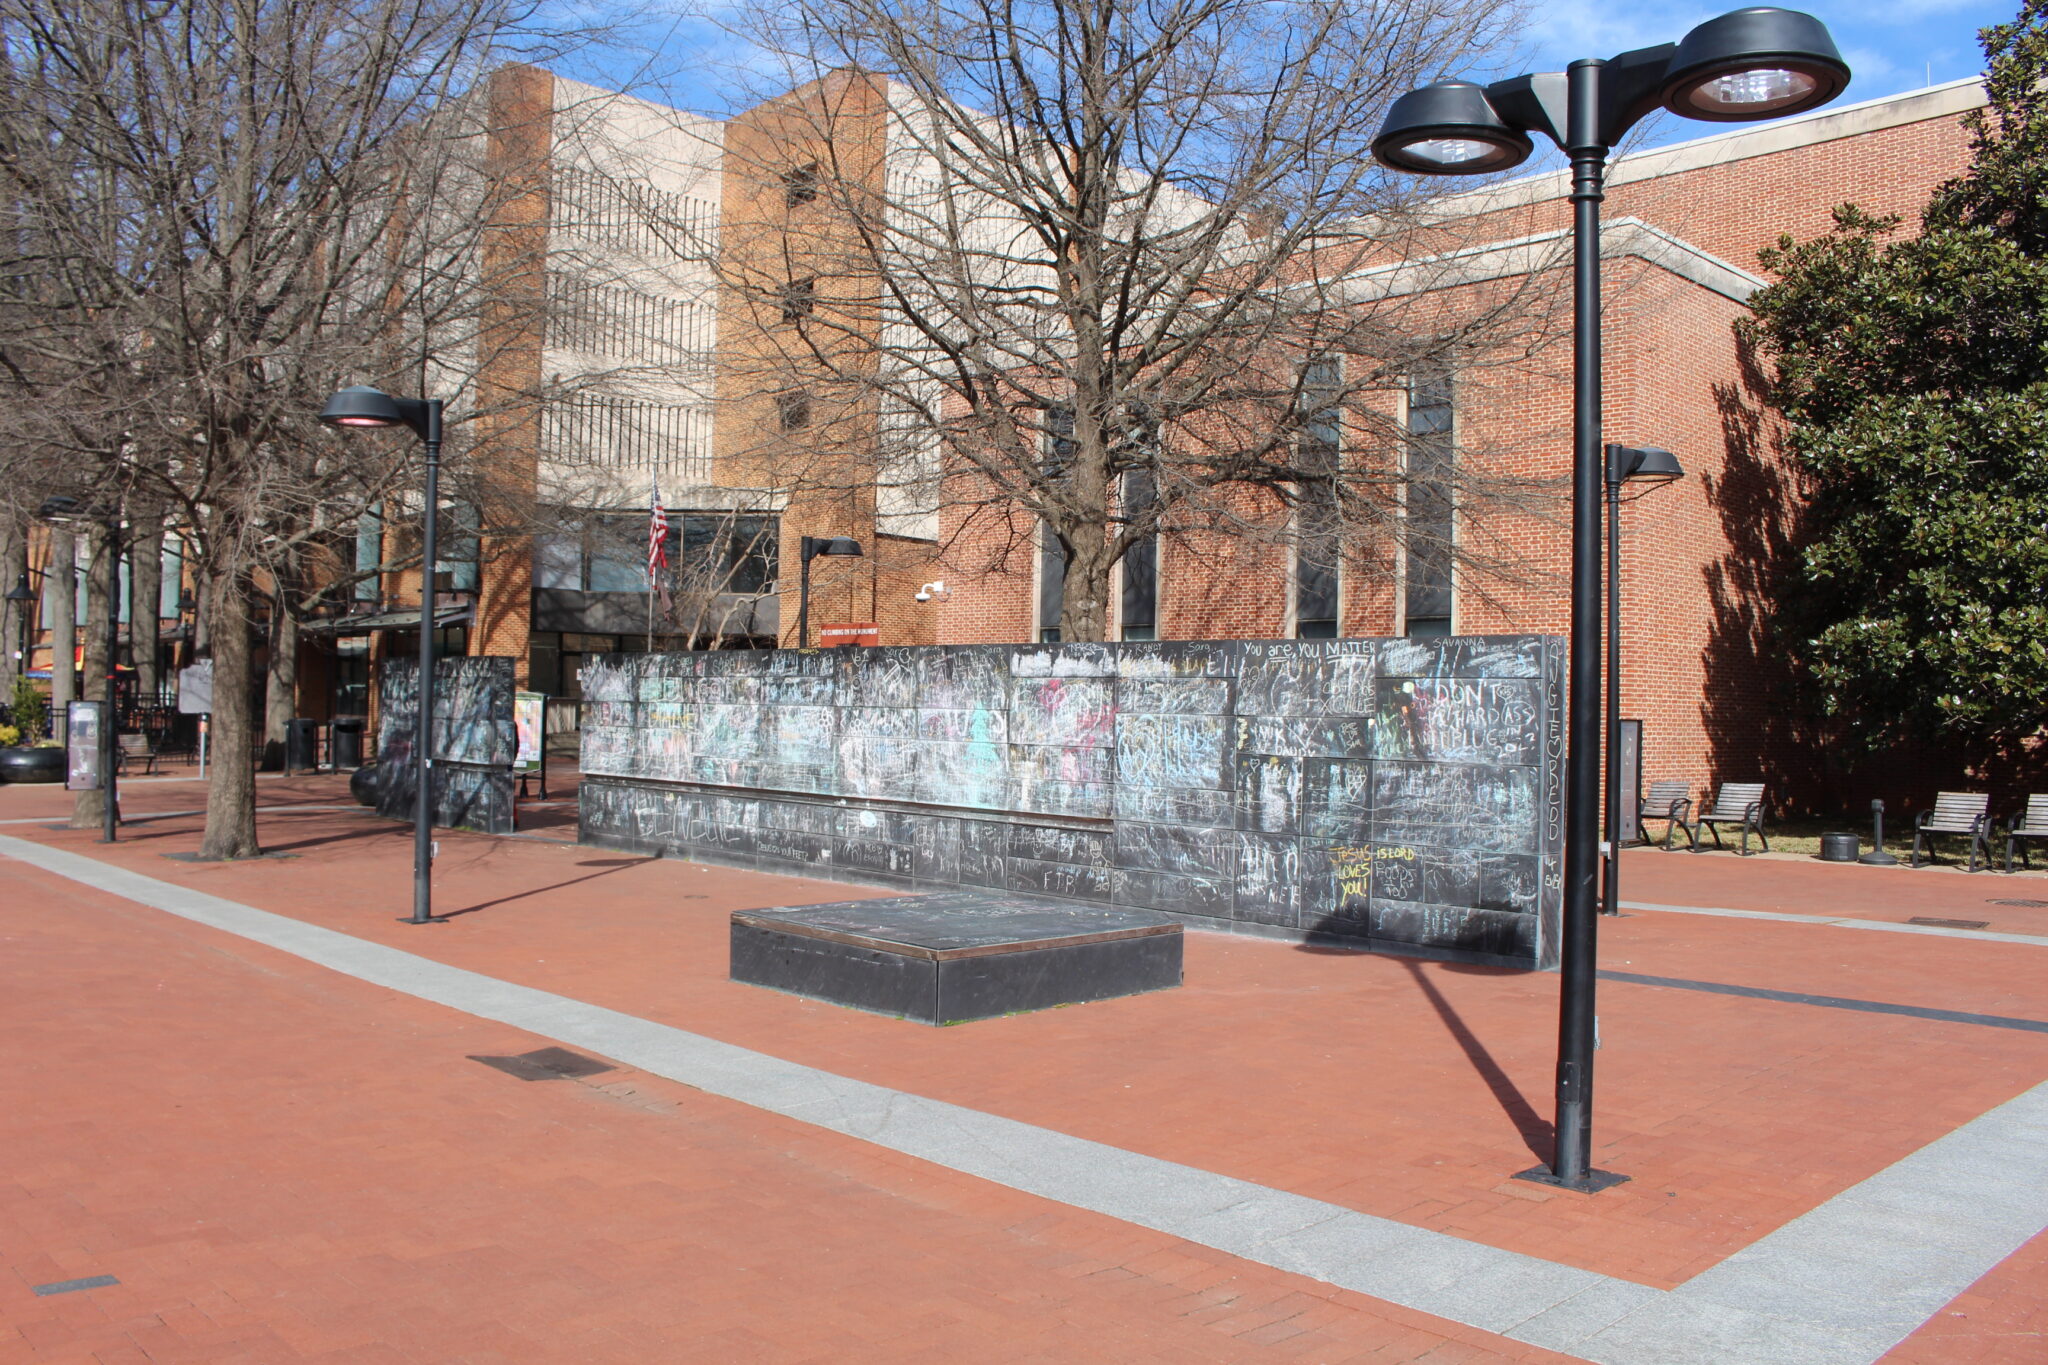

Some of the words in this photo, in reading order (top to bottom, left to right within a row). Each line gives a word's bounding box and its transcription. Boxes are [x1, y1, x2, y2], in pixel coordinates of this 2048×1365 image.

[1326, 640, 1376, 656] MATTER
[1433, 637, 1486, 649] SAVANNA
[1504, 705, 1535, 726] ASS
[1338, 862, 1370, 880] LOVES
